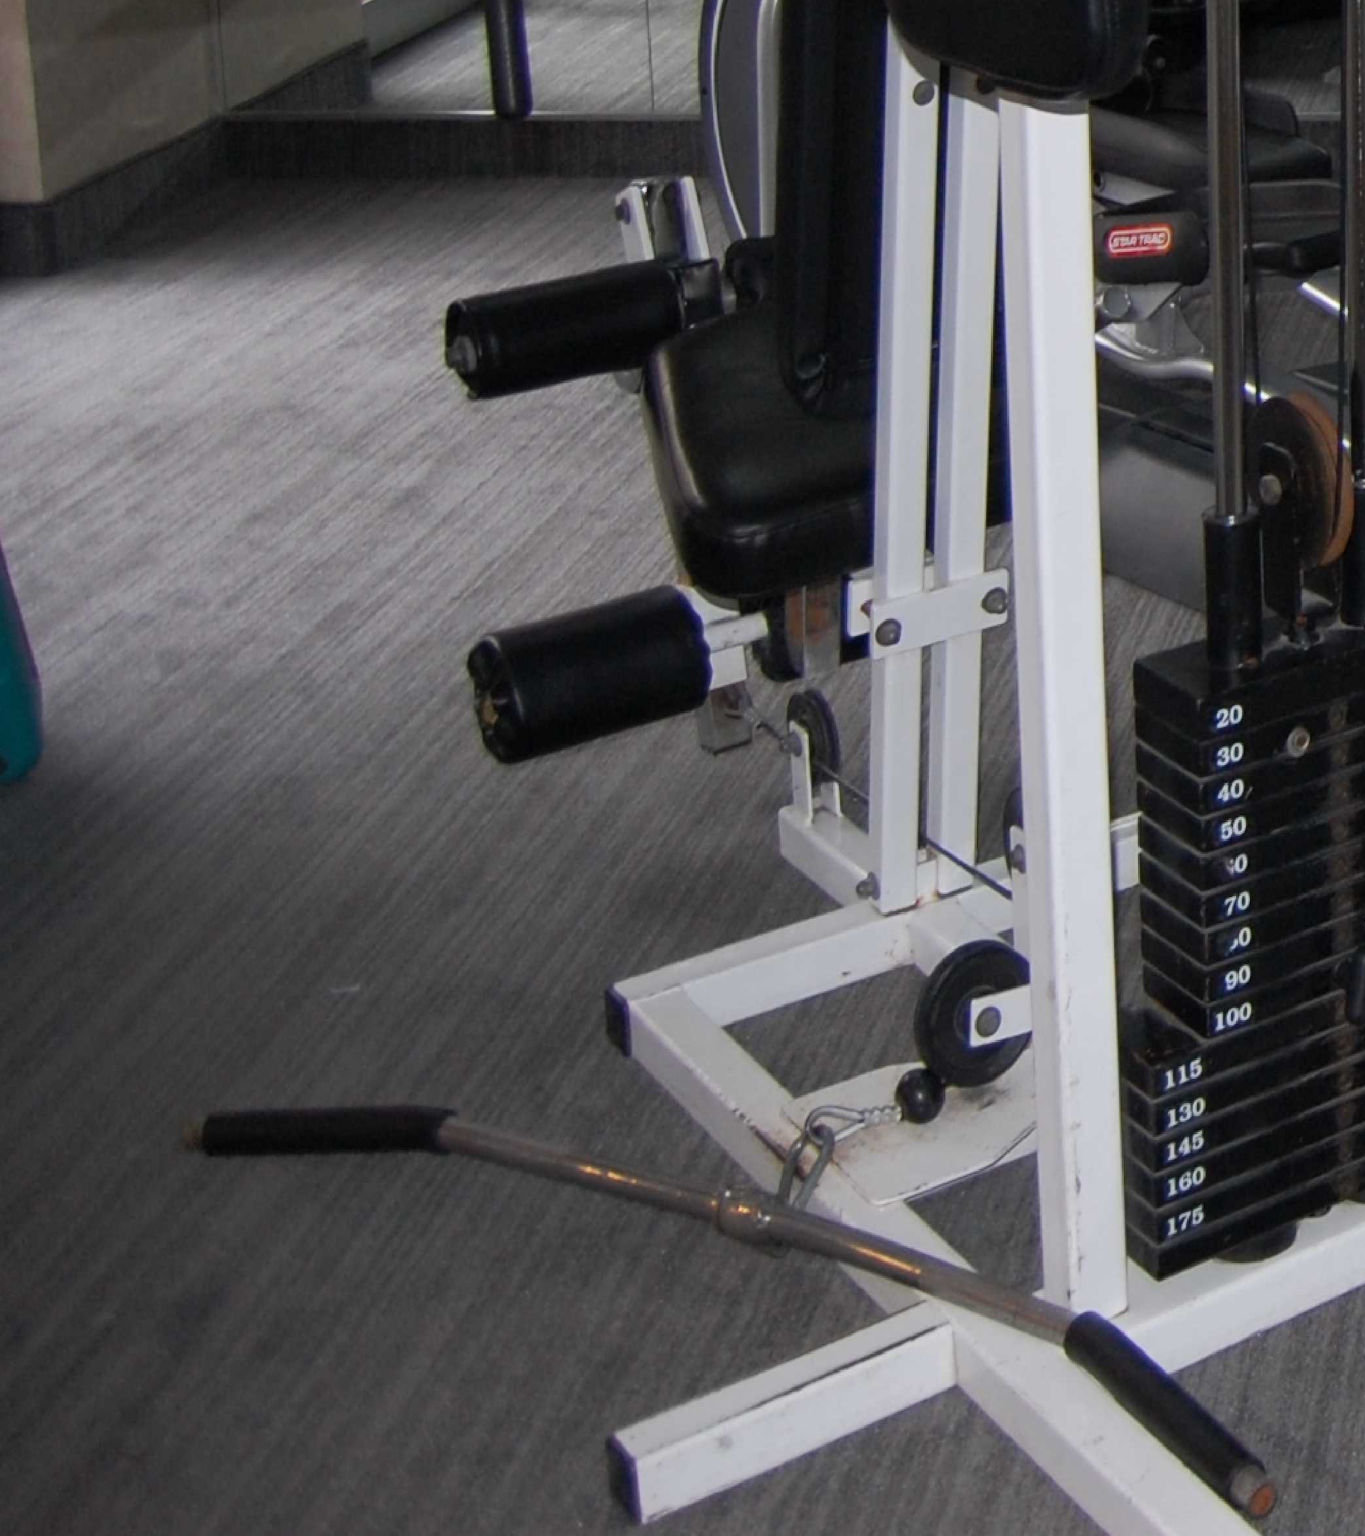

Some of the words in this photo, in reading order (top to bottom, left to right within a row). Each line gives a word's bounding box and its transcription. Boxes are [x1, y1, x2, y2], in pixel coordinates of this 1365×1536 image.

[1111, 235, 1138, 250] STAR
[1139, 231, 1166, 246] TRAC
[1216, 704, 1243, 729] 20
[1216, 742, 1244, 767] 30
[1217, 779, 1244, 803] 40
[1219, 816, 1247, 842] 50
[1223, 891, 1250, 916] 70
[1224, 965, 1251, 992] 90
[1213, 1002, 1252, 1032] 100
[1163, 1058, 1203, 1091] 115
[1166, 1097, 1206, 1130] 130
[1166, 1130, 1205, 1162] 145
[1166, 1166, 1206, 1199] 160
[1166, 1204, 1205, 1237] 175
